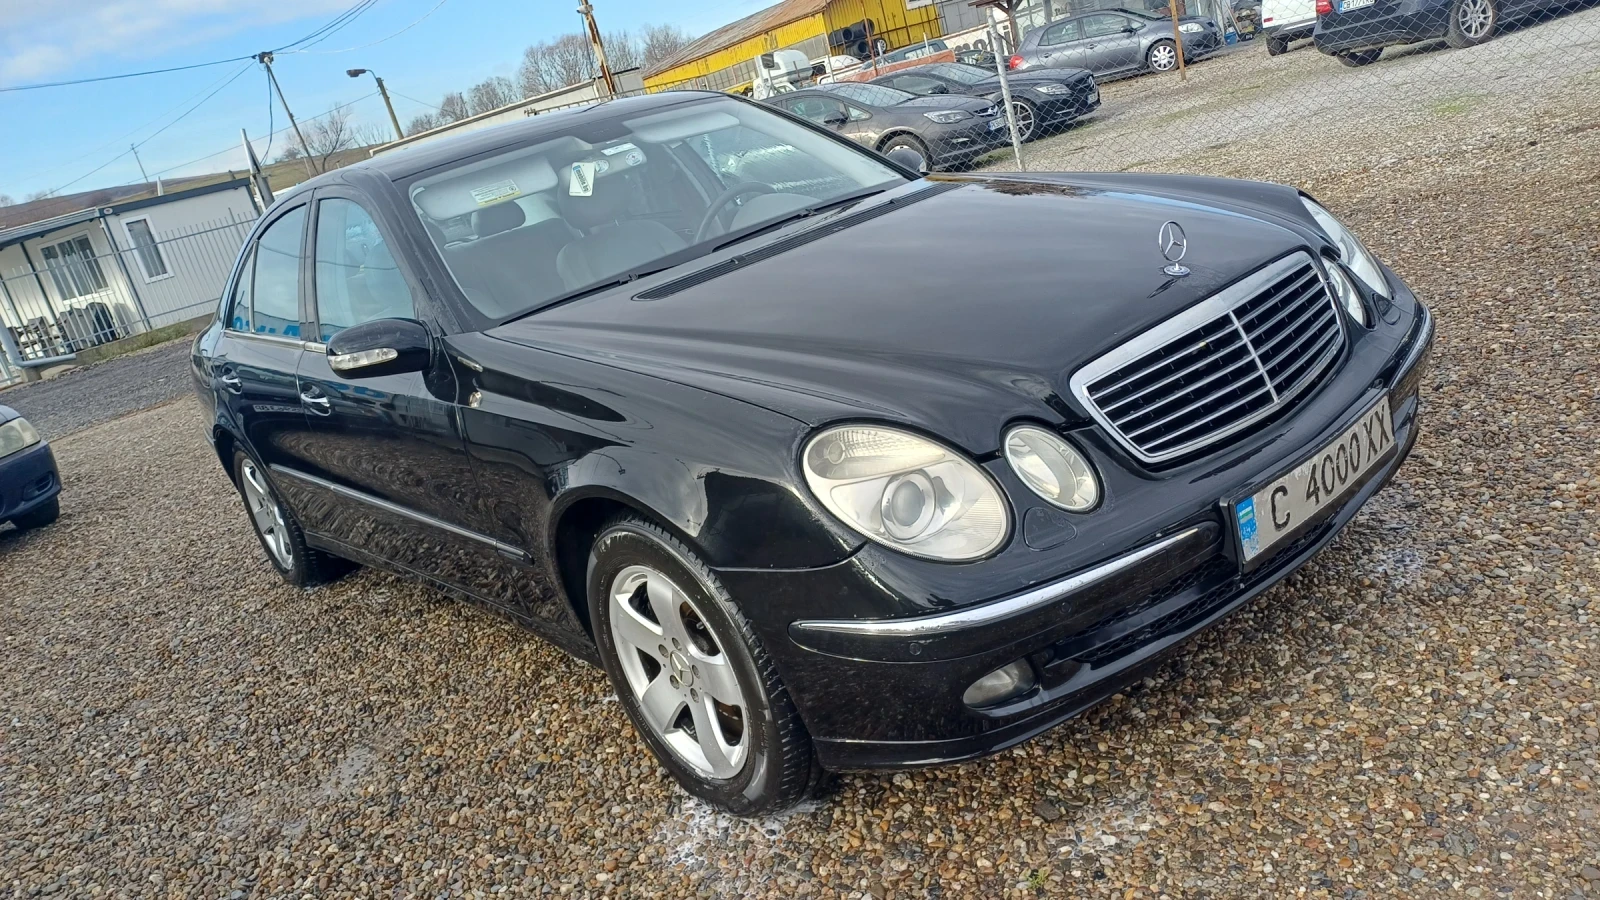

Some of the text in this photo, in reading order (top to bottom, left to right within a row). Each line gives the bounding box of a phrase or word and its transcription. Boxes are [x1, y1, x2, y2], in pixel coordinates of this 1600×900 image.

[1270, 404, 1390, 531] C 4000 XX
